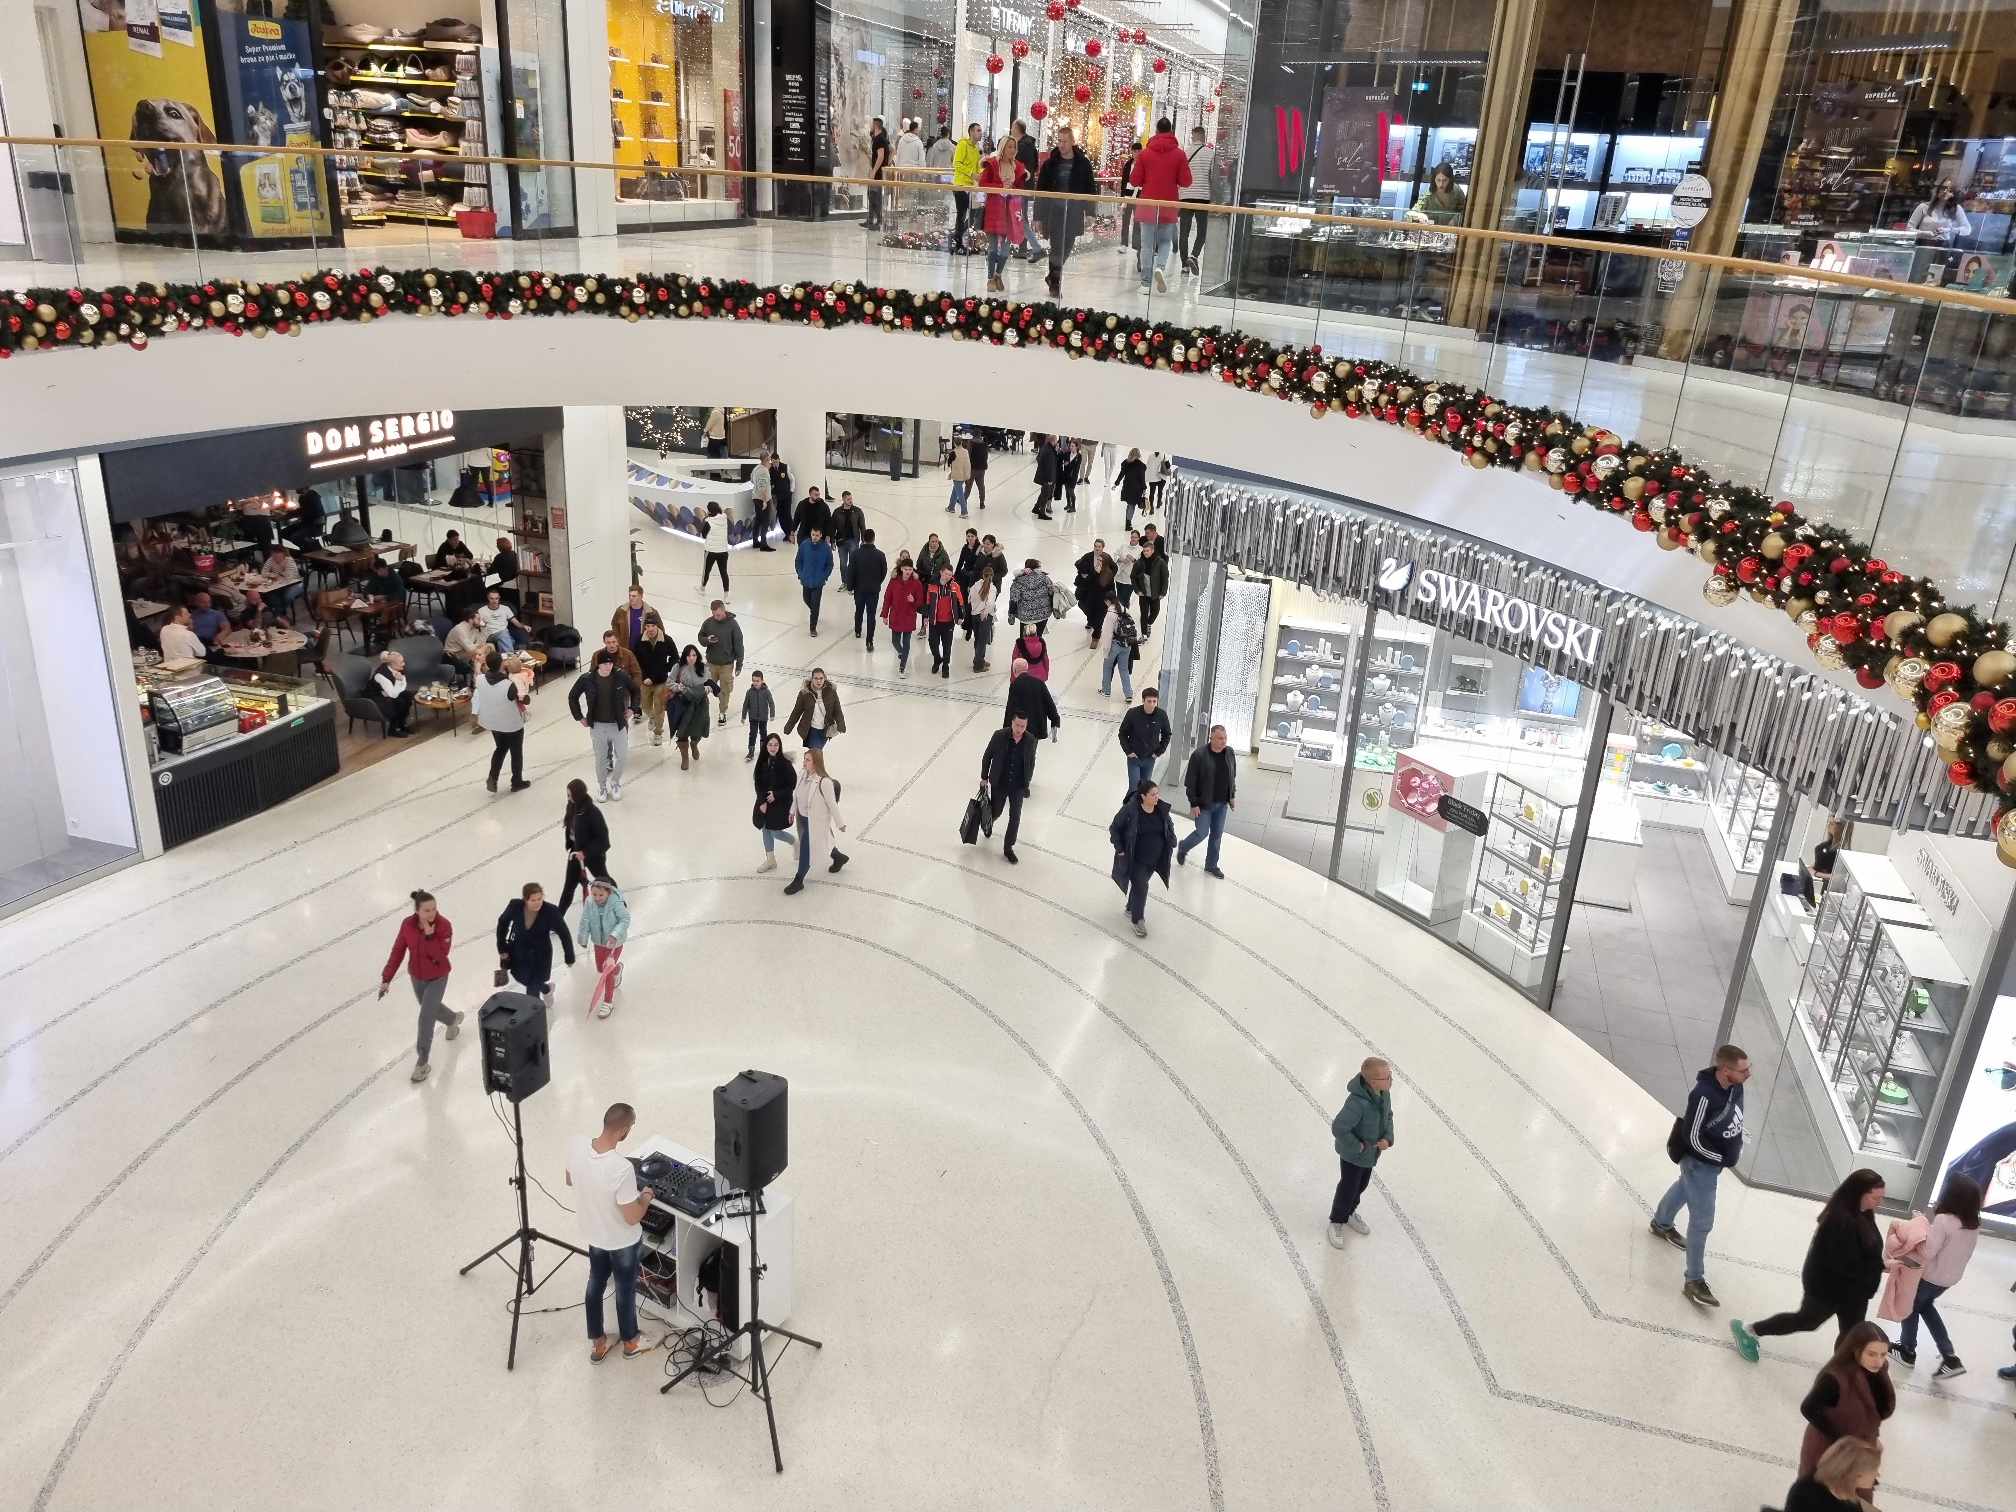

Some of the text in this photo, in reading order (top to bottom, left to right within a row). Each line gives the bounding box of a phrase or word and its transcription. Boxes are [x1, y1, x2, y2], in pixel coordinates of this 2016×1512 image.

[1002, 7, 1034, 36] TIFFANY
[306, 424, 361, 455] DON
[369, 409, 454, 443] SERGIO
[1417, 569, 1602, 665] SWAROVSKI
